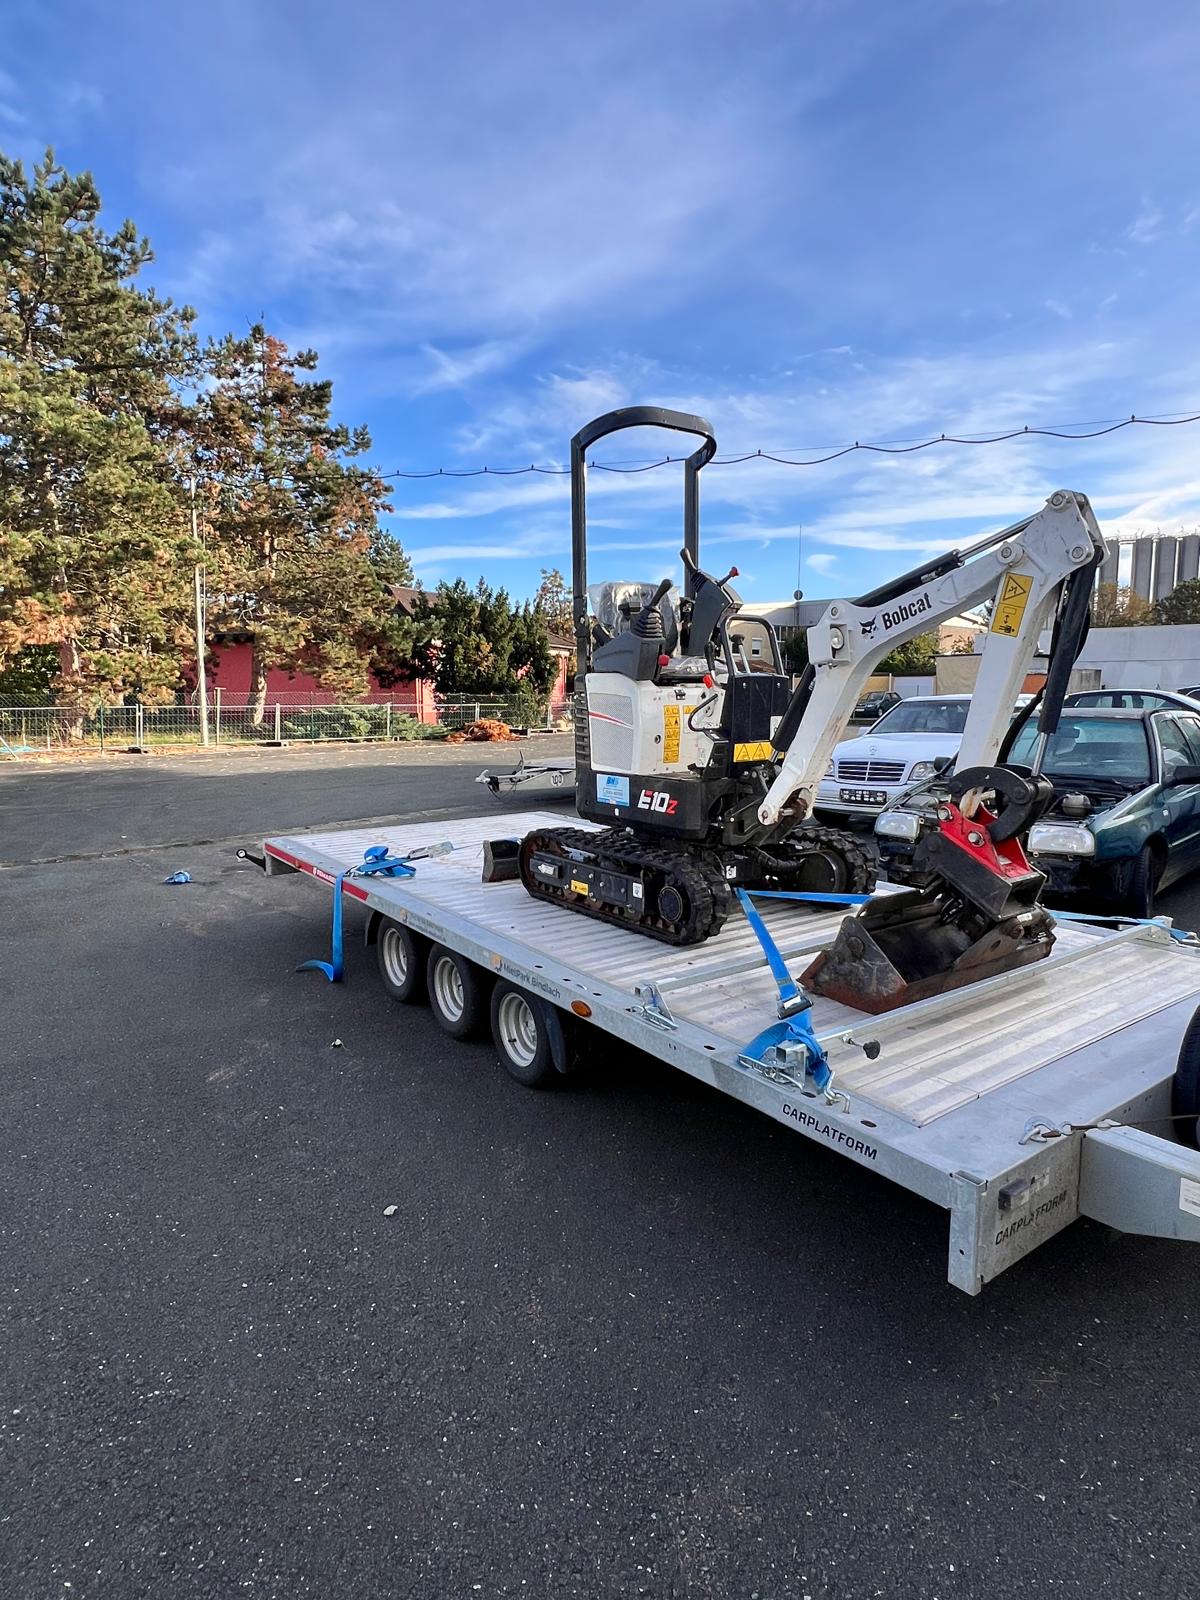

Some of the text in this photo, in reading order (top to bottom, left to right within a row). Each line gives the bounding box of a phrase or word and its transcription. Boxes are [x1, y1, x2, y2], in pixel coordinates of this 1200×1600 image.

[881, 592, 932, 631] Bobcat
[531, 976, 561, 999] Bindlach
[782, 1103, 878, 1160] CARPLATFORM
[995, 1190, 1067, 1245] CARPLATFORM
